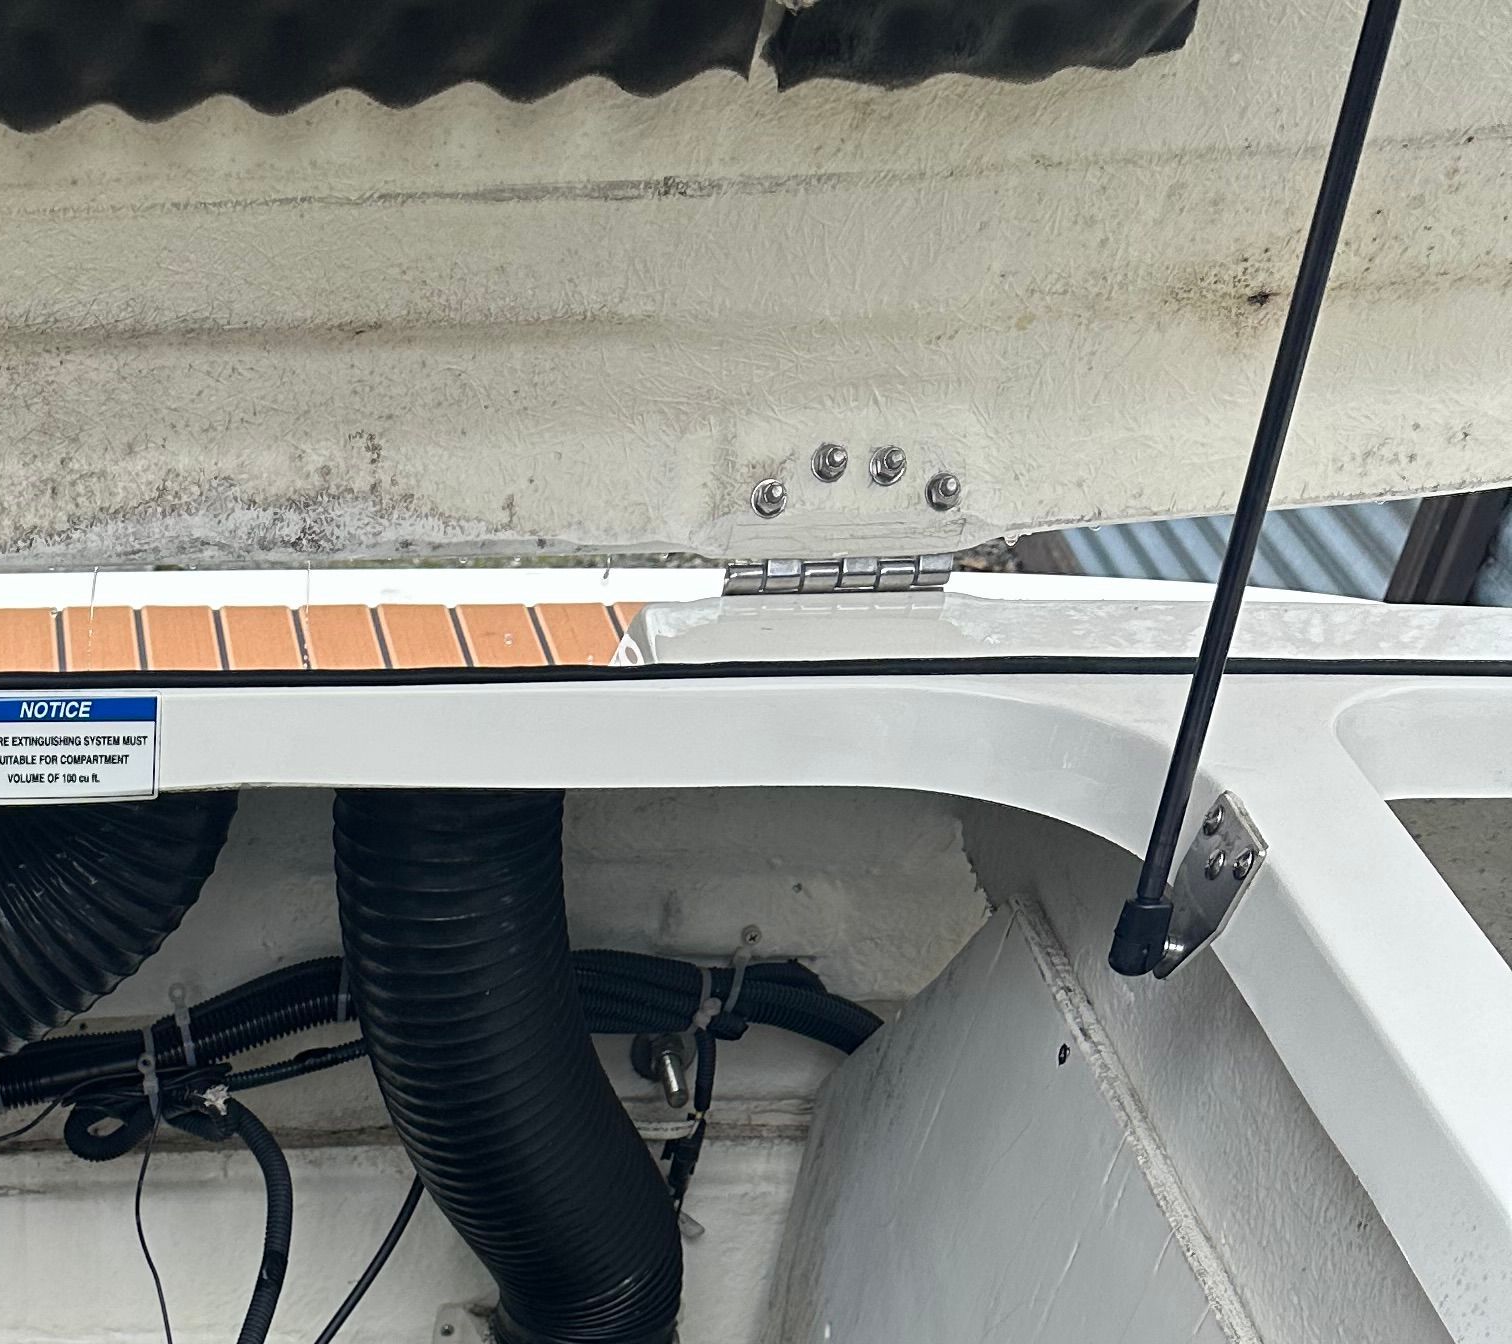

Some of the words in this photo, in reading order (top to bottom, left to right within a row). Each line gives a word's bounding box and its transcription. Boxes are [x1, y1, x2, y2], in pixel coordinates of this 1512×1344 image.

[20, 702, 91, 718] NOTICE
[12, 736, 81, 746] EXTINGUISHING
[84, 736, 120, 745] SYSTEM
[123, 736, 148, 745] MUST
[40, 755, 57, 764] FOR
[60, 755, 129, 764] COMPARTMENT
[8, 774, 45, 783] VOLUME
[48, 774, 60, 782] OF
[63, 774, 76, 782] 100
[92, 773, 100, 782] ft.
